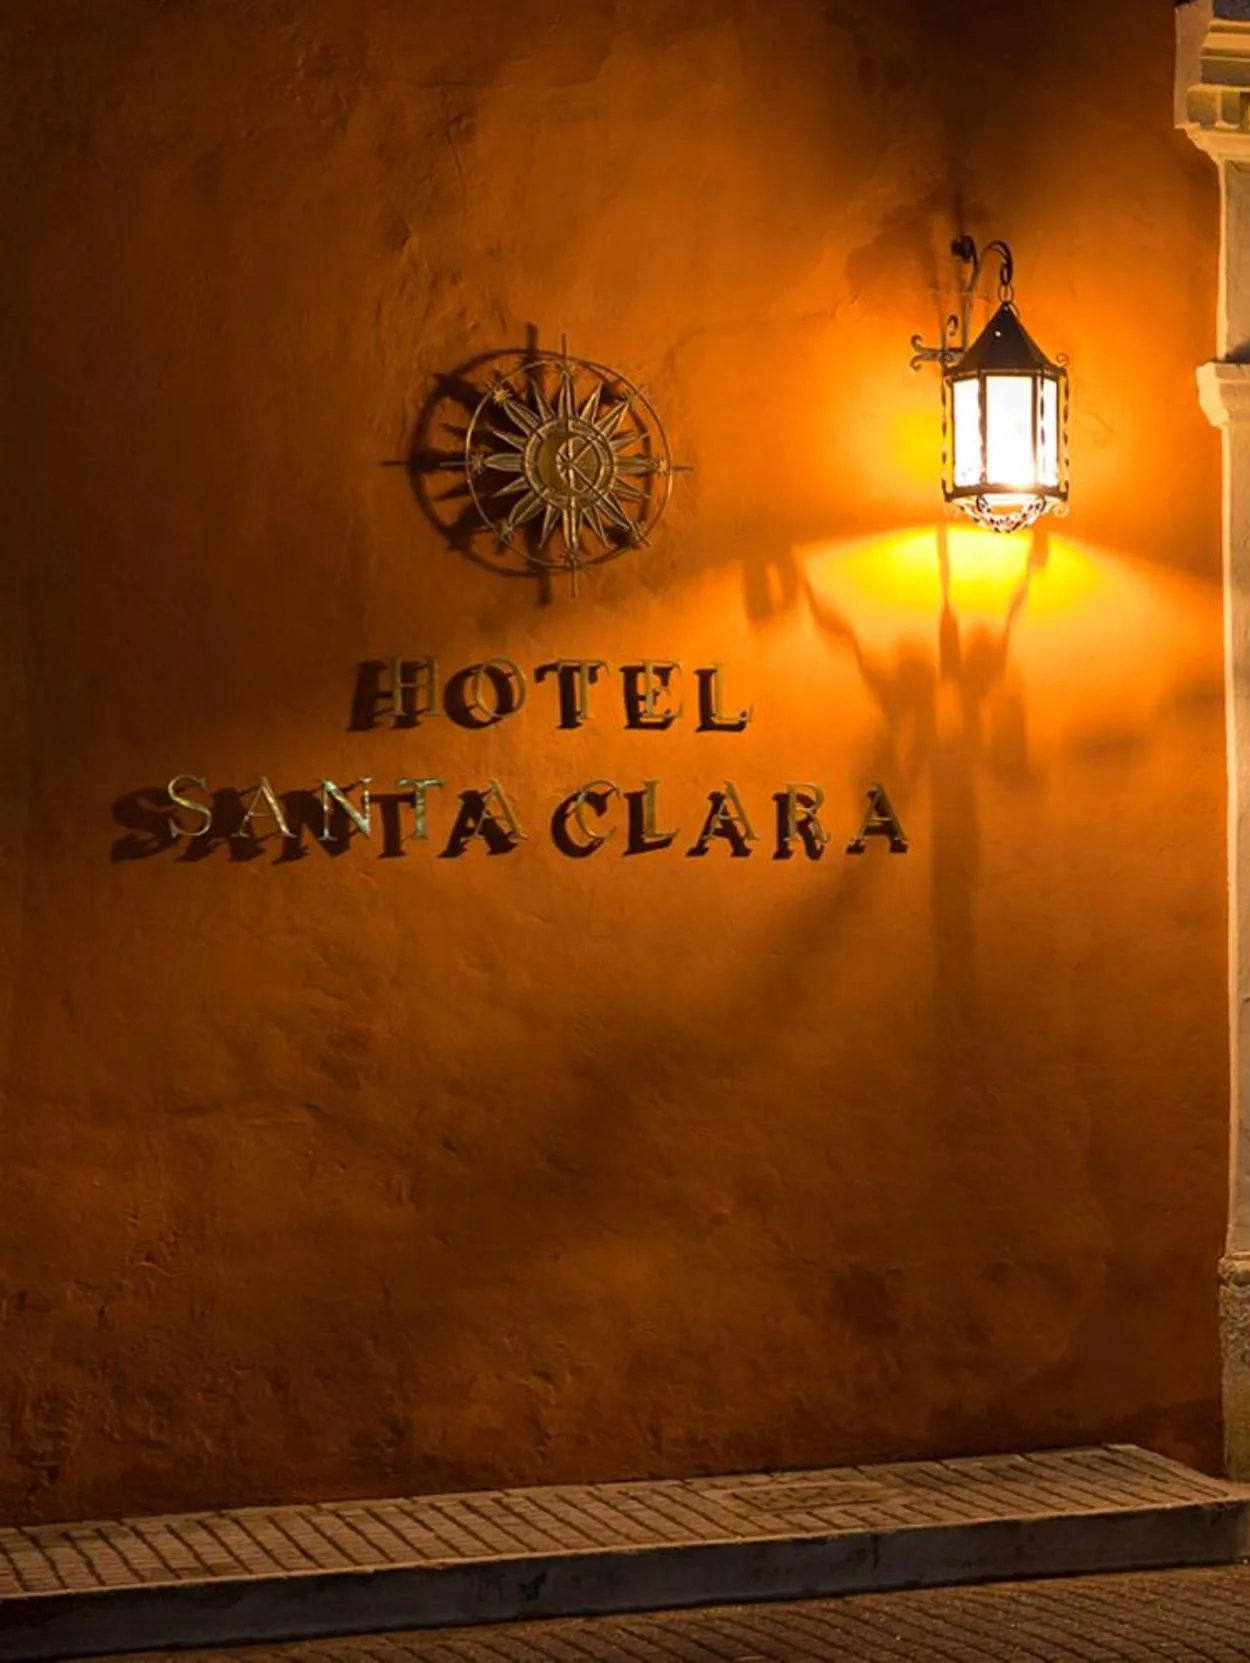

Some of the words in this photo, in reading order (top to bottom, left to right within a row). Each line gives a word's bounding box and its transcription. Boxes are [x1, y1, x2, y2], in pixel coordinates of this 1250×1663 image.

[391, 654, 753, 724] HOTEL
[168, 775, 528, 843] SANTA
[574, 779, 906, 845] CLARA
